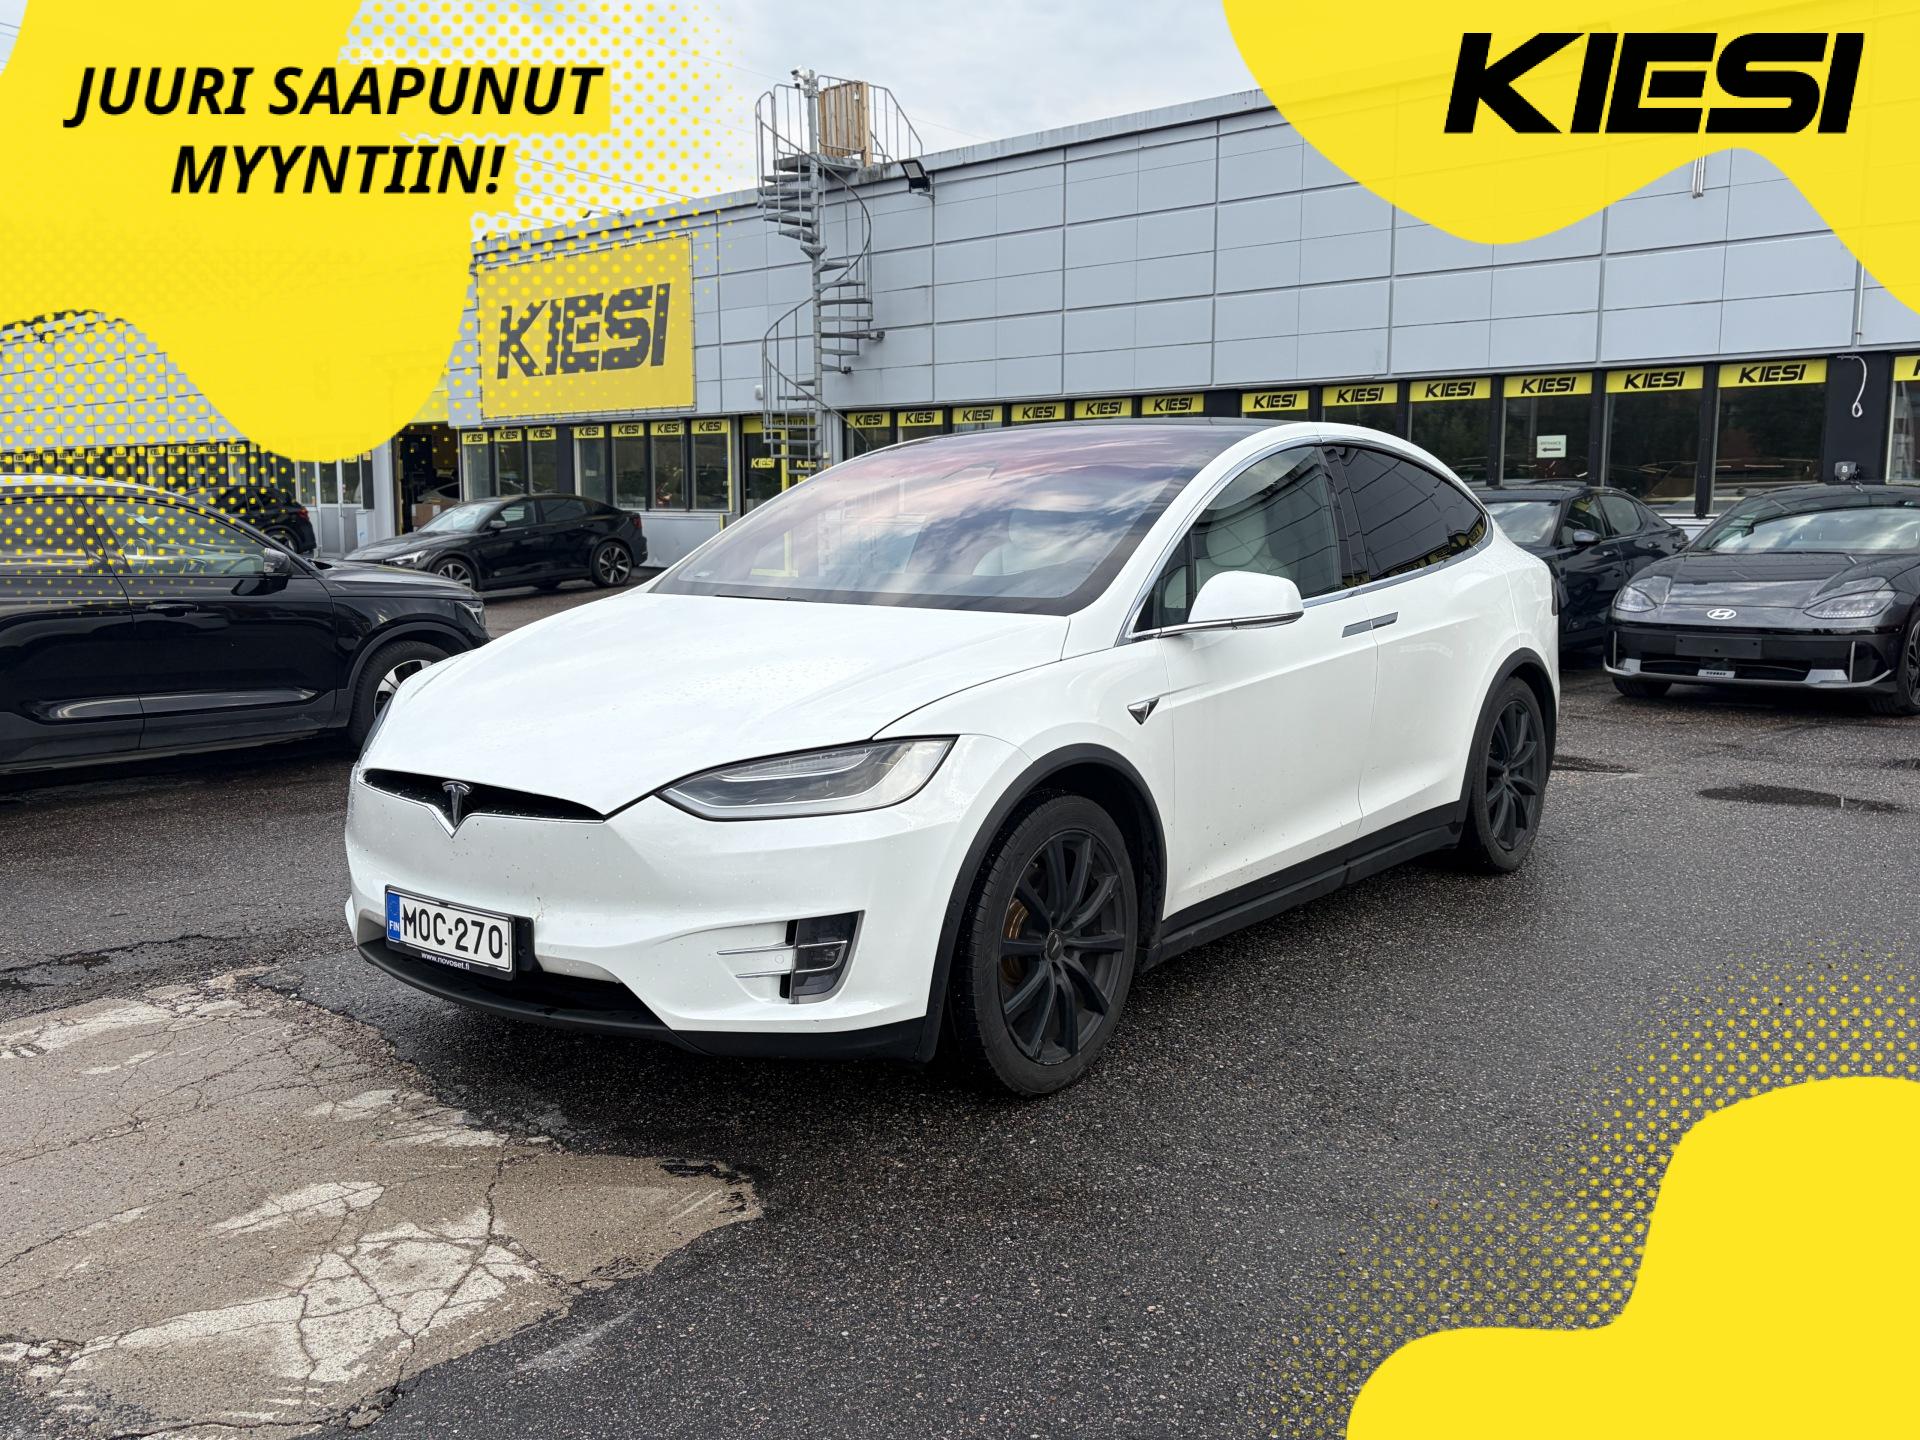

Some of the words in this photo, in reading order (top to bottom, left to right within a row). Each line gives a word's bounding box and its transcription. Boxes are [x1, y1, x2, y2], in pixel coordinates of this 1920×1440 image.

[497, 283, 670, 379] KIESI
[1738, 364, 1807, 384] KIESI
[1520, 377, 1576, 394] KIESI
[1624, 371, 1685, 390] KIESI
[1336, 386, 1385, 404] KIESI
[1425, 381, 1477, 398] KIESI
[1153, 398, 1193, 412] KIESI
[1253, 393, 1297, 409] KIESI
[1022, 406, 1056, 419] KIESI
[1086, 402, 1123, 415] KIESI
[855, 415, 882, 426] KIESI
[905, 412, 934, 424] KIESI
[962, 410, 993, 422] KIESI
[579, 427, 598, 436] KIESI
[618, 425, 639, 434] KIESI
[657, 424, 679, 433] KIESI
[699, 422, 721, 431] KIESI
[500, 431, 517, 439] KIESI
[533, 429, 552, 438] KIESI
[751, 458, 775, 468] KIESI
[389, 920, 400, 931] FIN
[421, 952, 470, 970] www.novoset.fi
